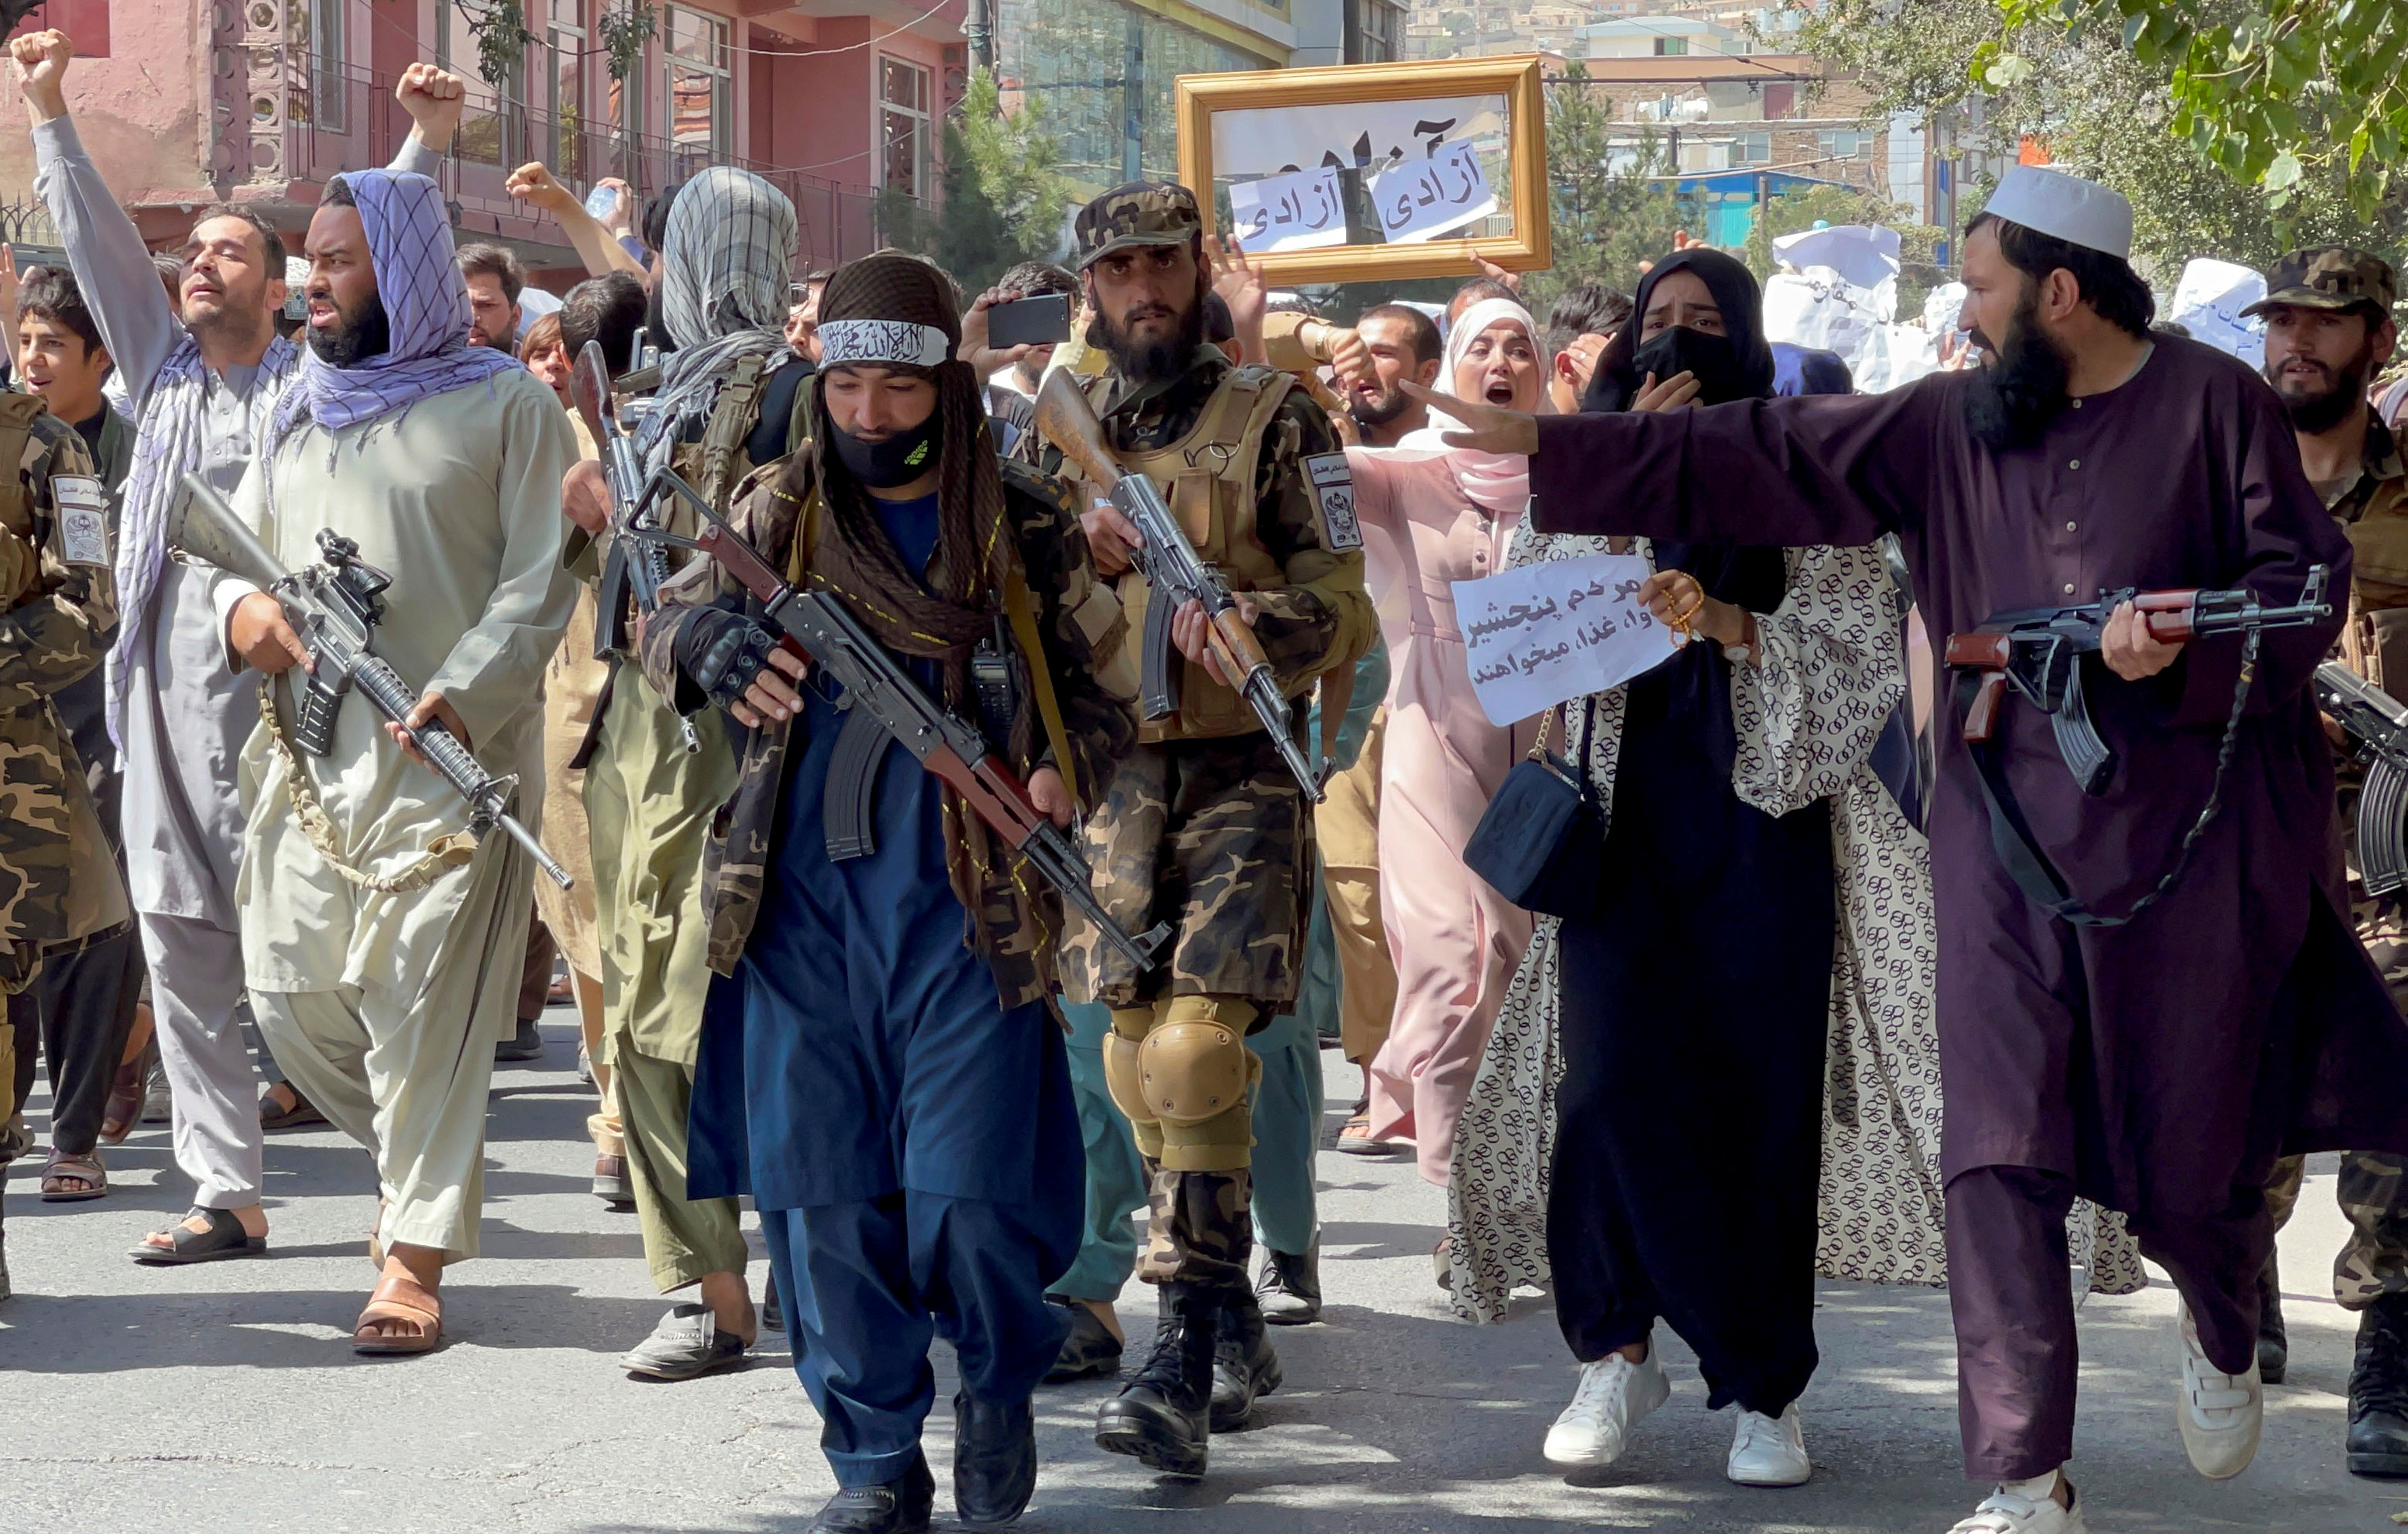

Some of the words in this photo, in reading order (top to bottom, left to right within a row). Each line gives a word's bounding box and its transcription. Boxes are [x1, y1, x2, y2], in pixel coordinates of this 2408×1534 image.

[1243, 173, 1339, 239] آزادی
[1387, 144, 1480, 230] آزادی
[1567, 578, 1642, 611] مردم
[1623, 608, 1653, 630] وا،
[1468, 594, 1563, 648] پنجشیر
[1473, 639, 1570, 685] میخواهند
